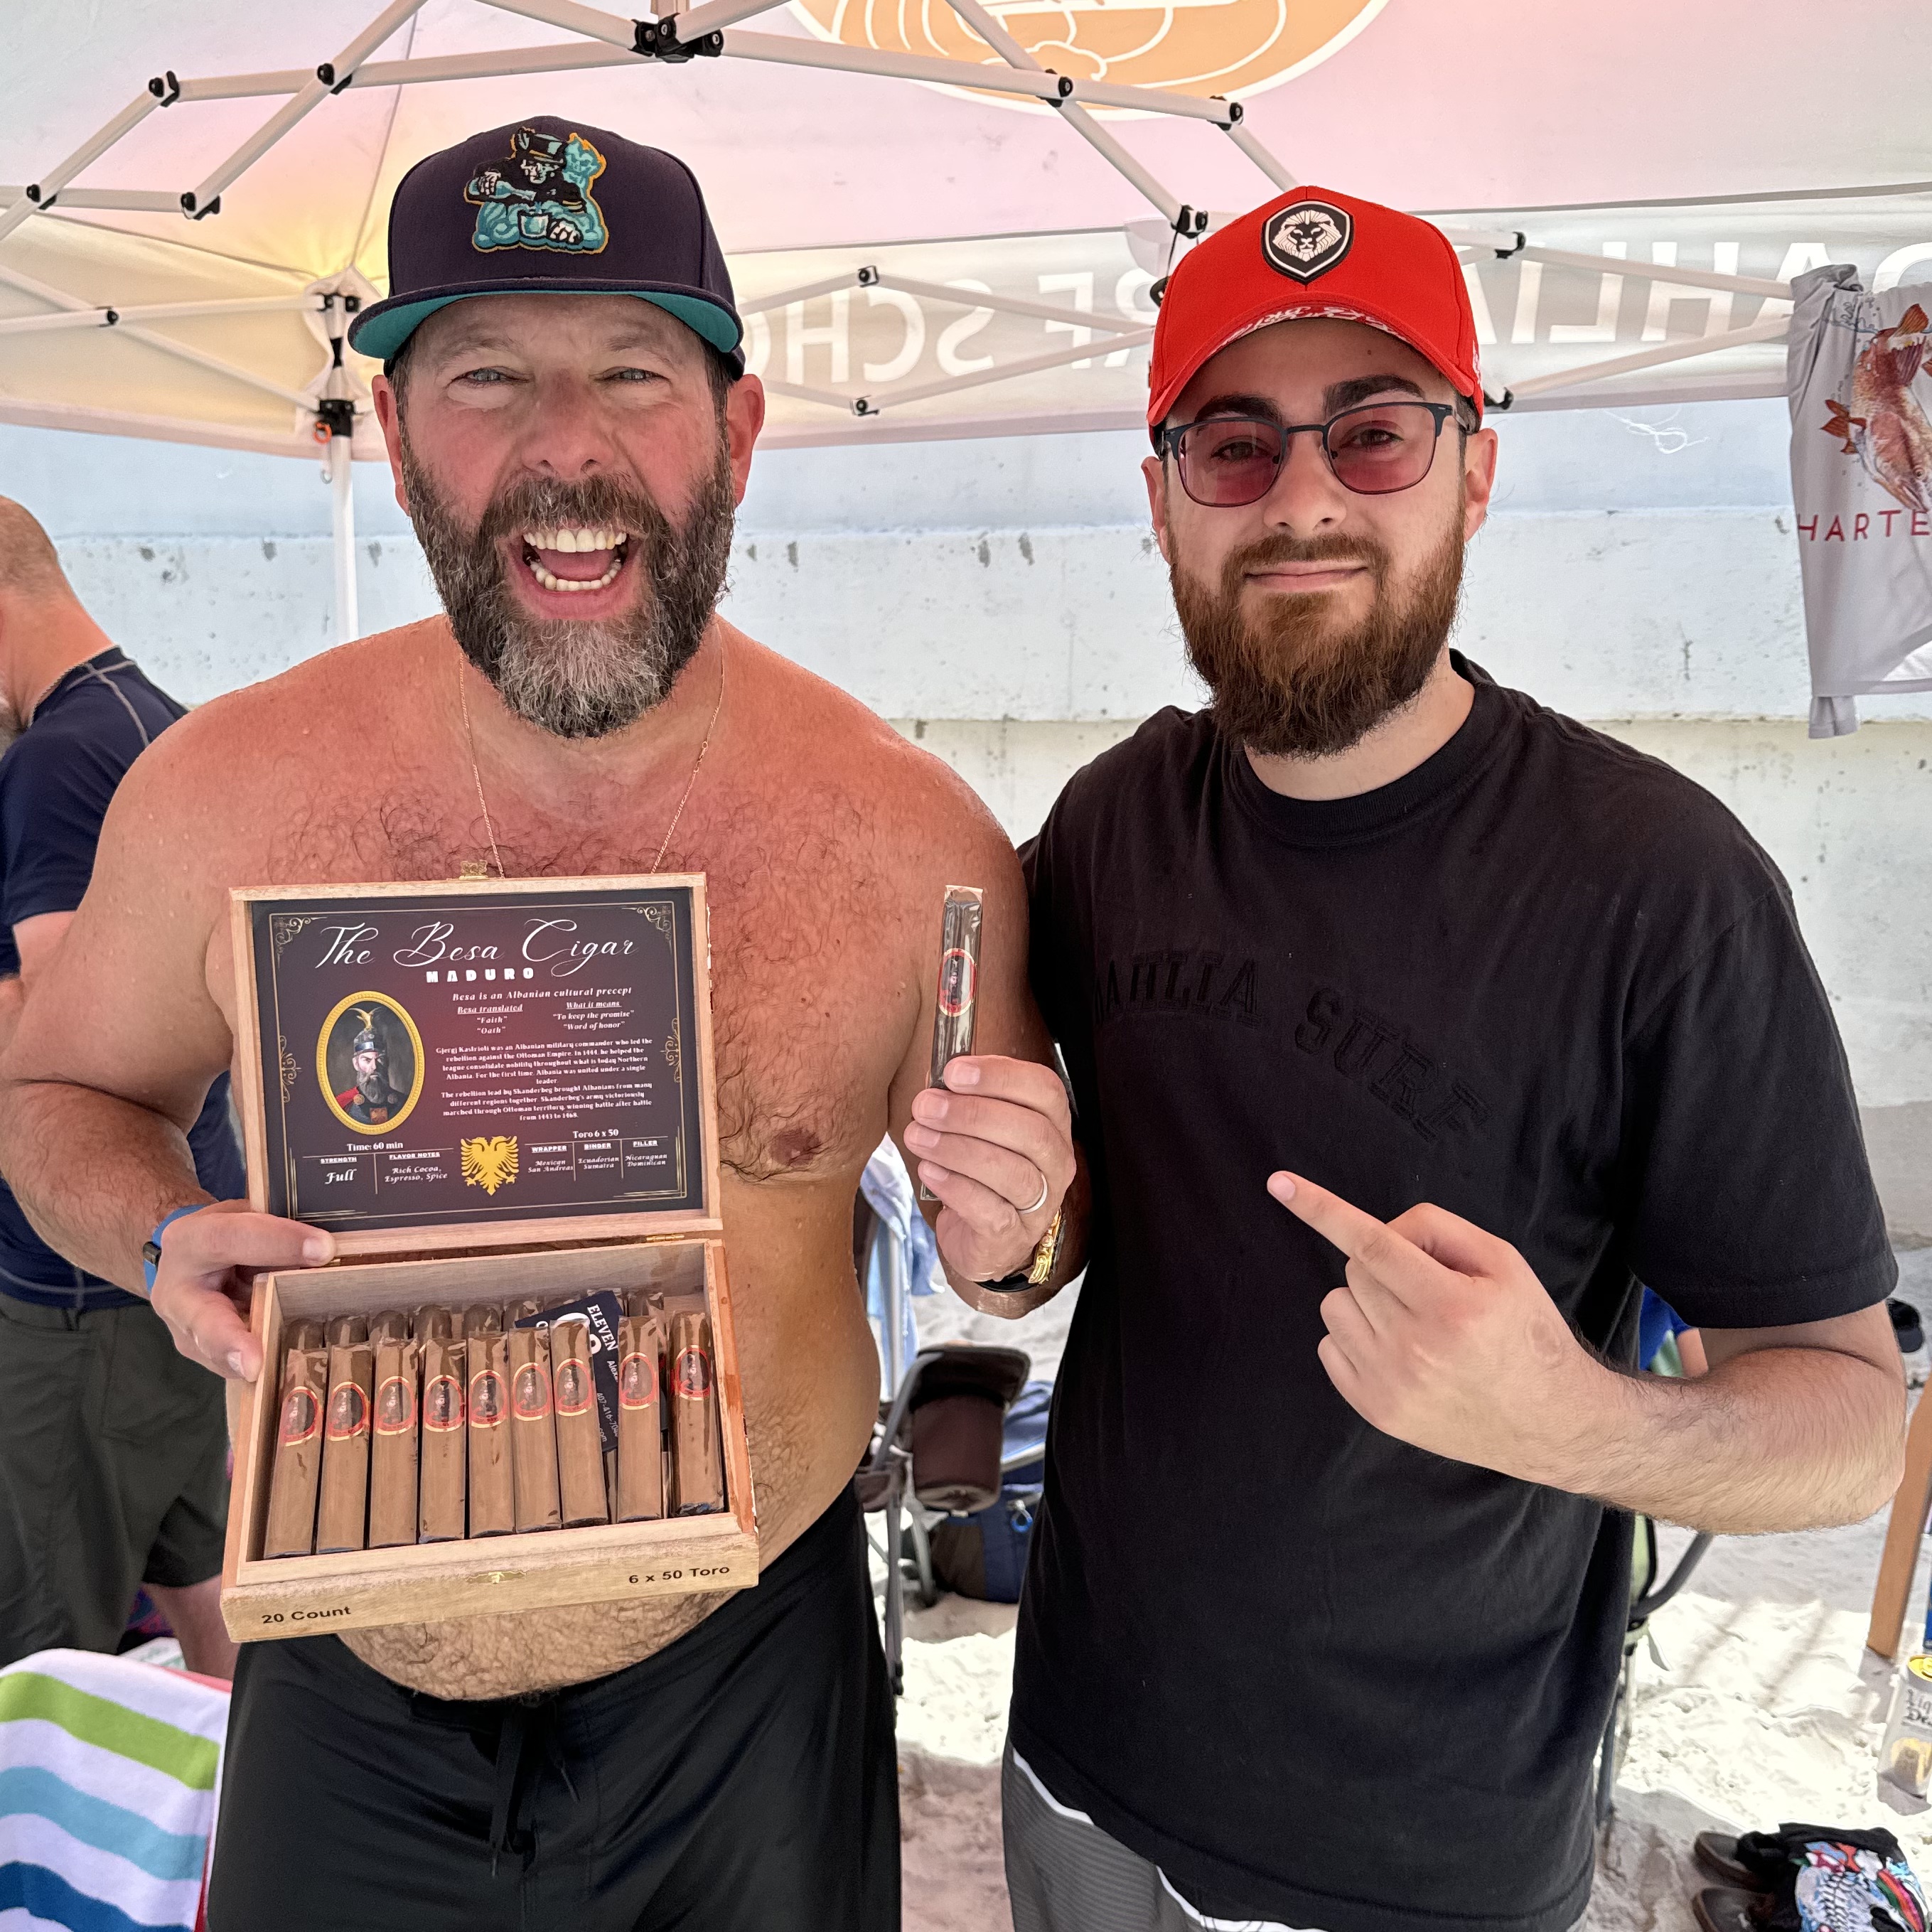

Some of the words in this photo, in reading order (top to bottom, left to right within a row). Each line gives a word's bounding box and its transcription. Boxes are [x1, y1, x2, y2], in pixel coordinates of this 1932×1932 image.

[315, 922, 378, 968] The
[393, 921, 504, 967] Besa
[522, 918, 638, 977] Cigar
[426, 967, 534, 983] MADURO
[506, 990, 550, 999] Albanian
[554, 988, 594, 997] cultural
[596, 987, 631, 997] precept
[480, 1004, 522, 1013] translated
[589, 1022, 598, 1031] of
[534, 1058, 571, 1067] throughout
[347, 1143, 372, 1152] Time:
[392, 1166, 412, 1174] Rich
[325, 1169, 358, 1184] Full
[426, 1173, 448, 1182] Spice
[586, 1304, 618, 1351] ELEVEN
[629, 1574, 639, 1584] 6
[662, 1570, 682, 1581] 50
[689, 1565, 730, 1577] Toro
[262, 1614, 284, 1624] 20
[291, 1606, 351, 1621] Count
